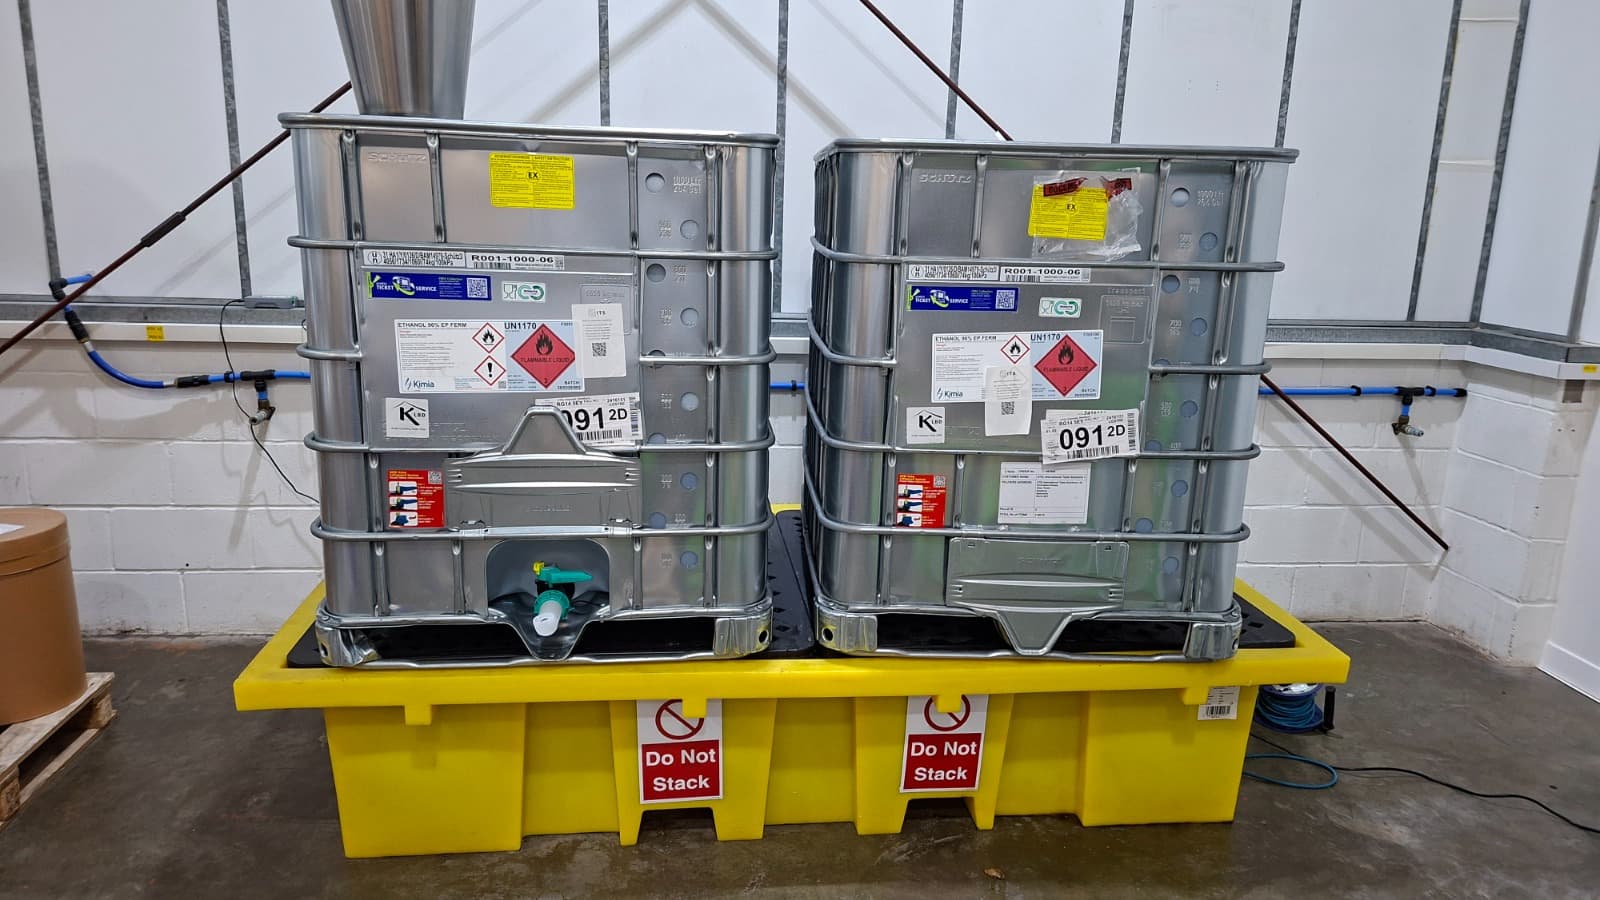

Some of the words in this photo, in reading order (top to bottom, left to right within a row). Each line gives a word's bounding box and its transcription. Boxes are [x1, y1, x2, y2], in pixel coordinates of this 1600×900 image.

[527, 171, 539, 179] EX
[471, 254, 554, 264] R001-1000-06
[1003, 267, 1081, 276] R001-1000-06
[504, 322, 537, 330] UN1170
[1030, 333, 1061, 341] UN1170
[413, 380, 435, 388] Kimia
[944, 390, 964, 398] Kimia
[399, 406, 421, 426] K
[608, 408, 628, 421] 2D
[918, 415, 937, 433] K
[1059, 424, 1103, 450] 091
[1107, 424, 1126, 437] 2D
[910, 741, 938, 757] Do
[943, 741, 978, 756] Not
[645, 751, 674, 767] Do
[680, 748, 716, 765] Not
[913, 766, 968, 782] Stack
[652, 774, 711, 792] Stack
